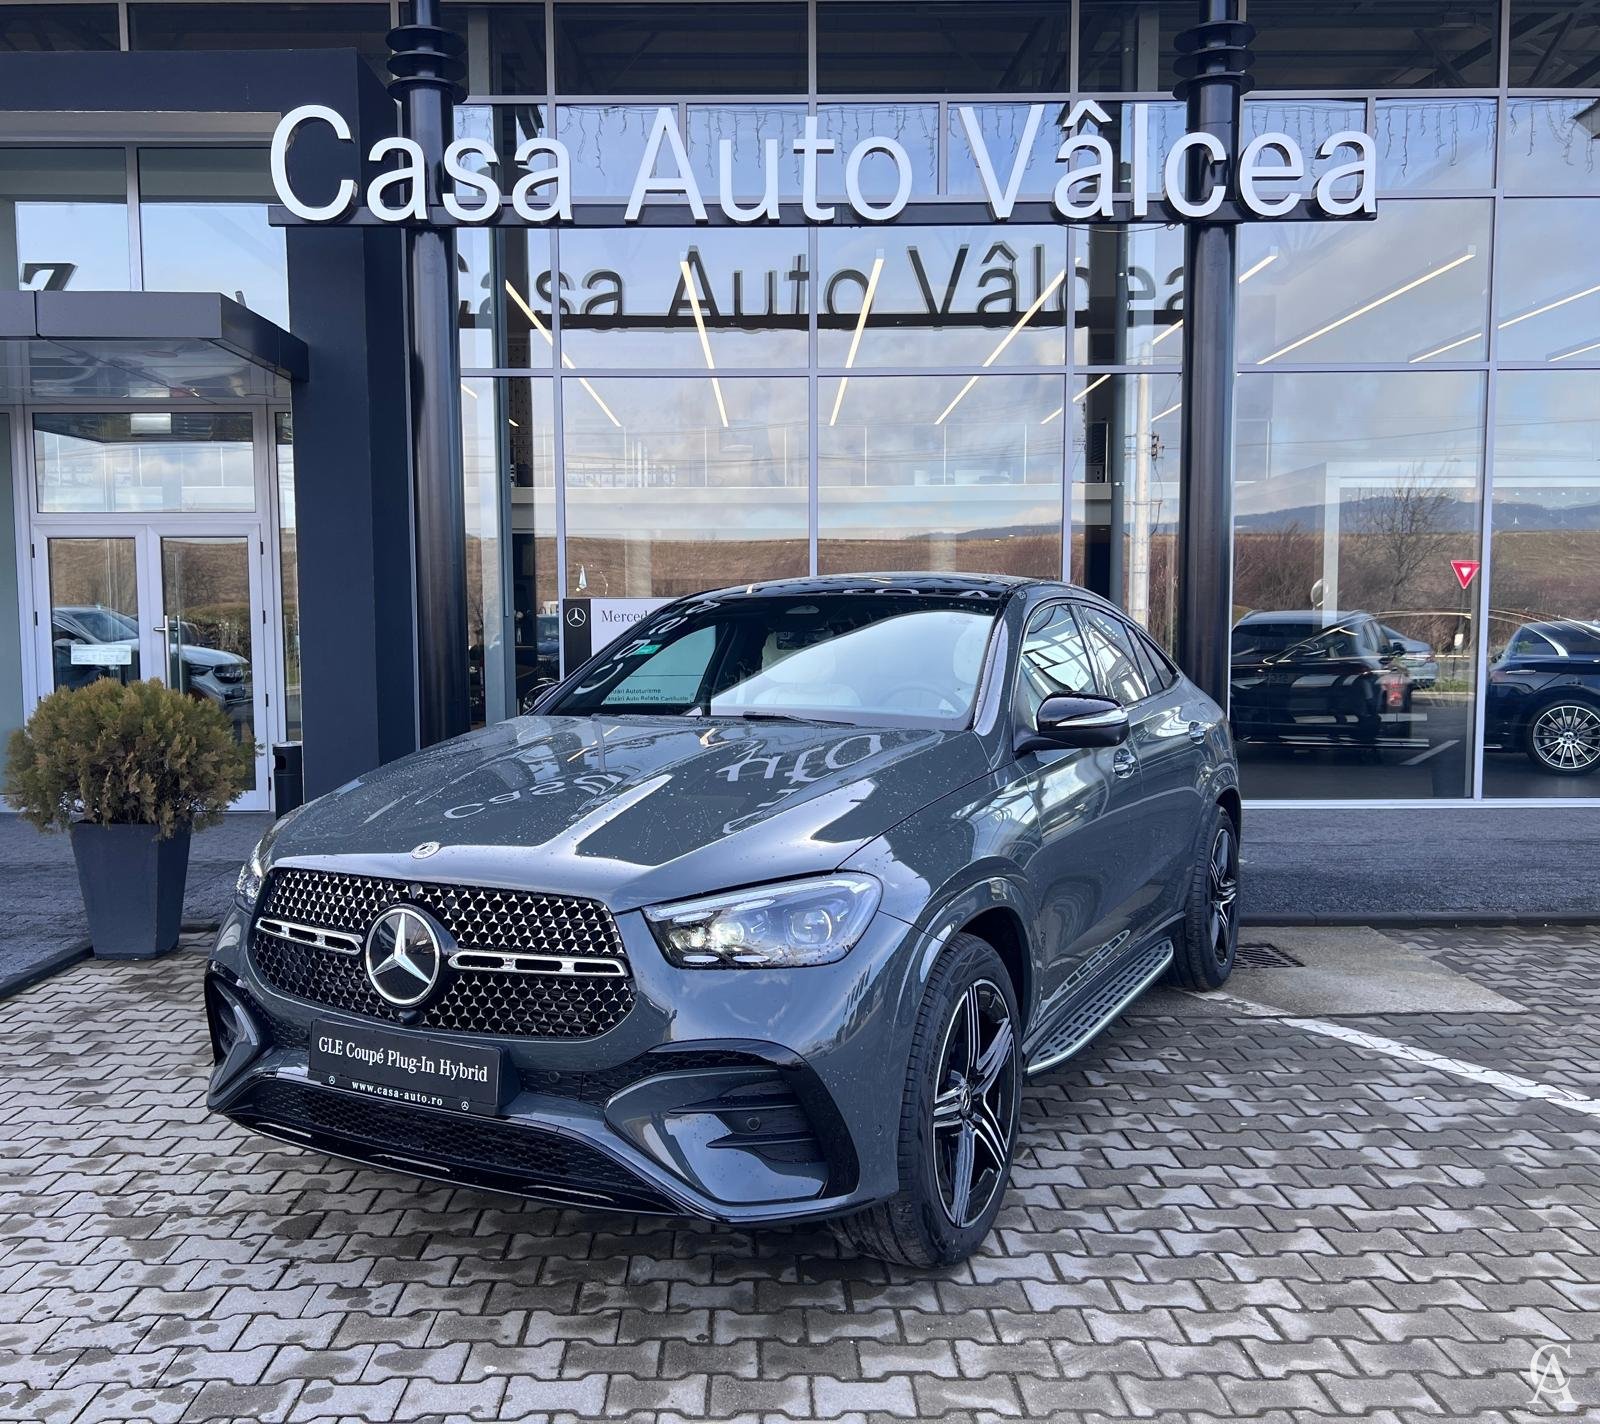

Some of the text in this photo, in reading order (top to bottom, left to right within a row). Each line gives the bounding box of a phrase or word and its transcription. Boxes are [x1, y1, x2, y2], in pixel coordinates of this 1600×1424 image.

[270, 99, 1377, 222] Casa Auto Vâlcea
[318, 1036, 488, 1083] GLE Coupé Plug-In Hybrid
[351, 1081, 443, 1106] www.casa-auto.ro
